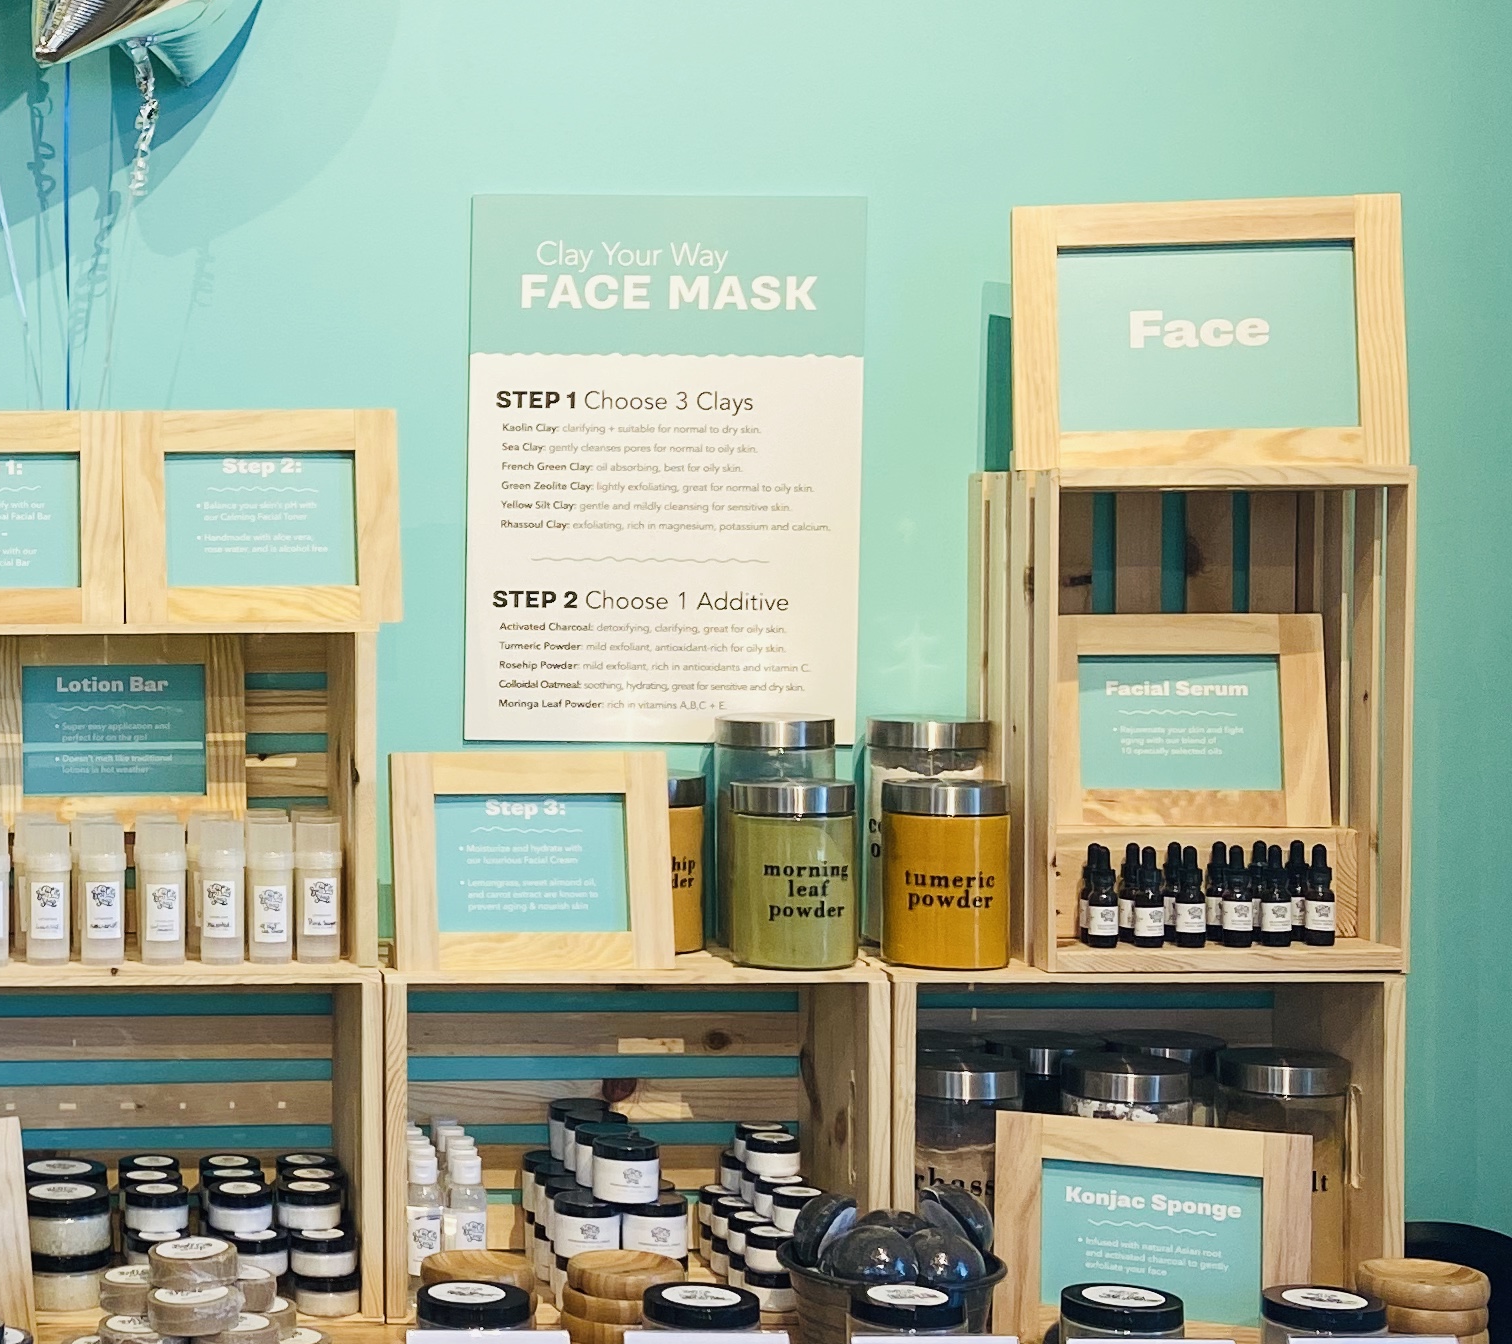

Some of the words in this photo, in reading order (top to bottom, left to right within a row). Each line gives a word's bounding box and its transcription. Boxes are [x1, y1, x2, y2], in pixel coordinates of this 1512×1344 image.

[536, 240, 594, 272] Clay
[601, 241, 662, 266] Your
[671, 241, 728, 274] Way
[520, 274, 651, 309] FACE
[668, 275, 817, 311] MASK
[1129, 310, 1270, 349] Face
[496, 390, 560, 409] STEP
[566, 391, 576, 408] 1
[584, 390, 667, 410] Choose
[676, 391, 688, 410] 3
[696, 391, 753, 416] Clays
[502, 422, 533, 433] Kaolin
[562, 422, 606, 436] clarifying
[618, 423, 655, 434] suitable
[657, 423, 671, 434] for
[673, 423, 707, 434] normal
[709, 423, 719, 435] to
[722, 423, 738, 437] dry
[502, 441, 520, 452] Sea
[549, 441, 579, 455] gently
[580, 442, 621, 453] cleanses
[624, 445, 652, 456] pores
[653, 442, 667, 454] for
[669, 443, 703, 454] normal
[705, 443, 715, 454] to
[717, 443, 735, 457] oily
[5, 460, 23, 475] 1:
[222, 457, 275, 477] Step
[280, 457, 302, 474] 2:
[502, 460, 535, 471] French
[536, 460, 567, 472] Green
[596, 461, 608, 472] oil
[663, 462, 685, 473] best
[687, 462, 700, 473] for
[703, 462, 720, 476] oily
[501, 479, 531, 490] Green
[533, 479, 568, 491] Zeolite
[596, 480, 625, 494] lightly
[682, 481, 707, 495] great
[710, 481, 724, 493] for
[726, 482, 759, 493] normal
[761, 482, 772, 493] to
[774, 482, 791, 496] oily
[500, 498, 533, 509] Yellow
[535, 498, 551, 510] Silt
[579, 499, 610, 513] gentle
[612, 499, 631, 511] and
[633, 500, 662, 513] mildly
[664, 500, 709, 514] cleansing
[711, 500, 725, 512] for
[727, 501, 768, 512] sensitive
[501, 518, 544, 529] Rhassoul
[627, 519, 645, 531] rich
[647, 519, 656, 531] in
[719, 520, 769, 534] potassium
[770, 521, 789, 532] and
[492, 590, 557, 609] STEP
[564, 591, 578, 609] 2
[585, 590, 668, 610] Choose
[678, 592, 686, 610] 1
[696, 591, 789, 611] Additive
[56, 676, 124, 693] Lotion
[129, 676, 169, 693] Bar
[1105, 680, 1170, 696] Facial
[1175, 681, 1249, 697] Serum
[485, 799, 538, 820] Step
[543, 799, 566, 816] 3:
[763, 862, 849, 881] morning
[905, 869, 995, 889] tumeric
[788, 879, 830, 898] leaf
[908, 889, 994, 911] powder
[769, 904, 845, 922] powder
[1065, 1185, 1145, 1211] Konjac
[1151, 1194, 1242, 1221] Sponge
